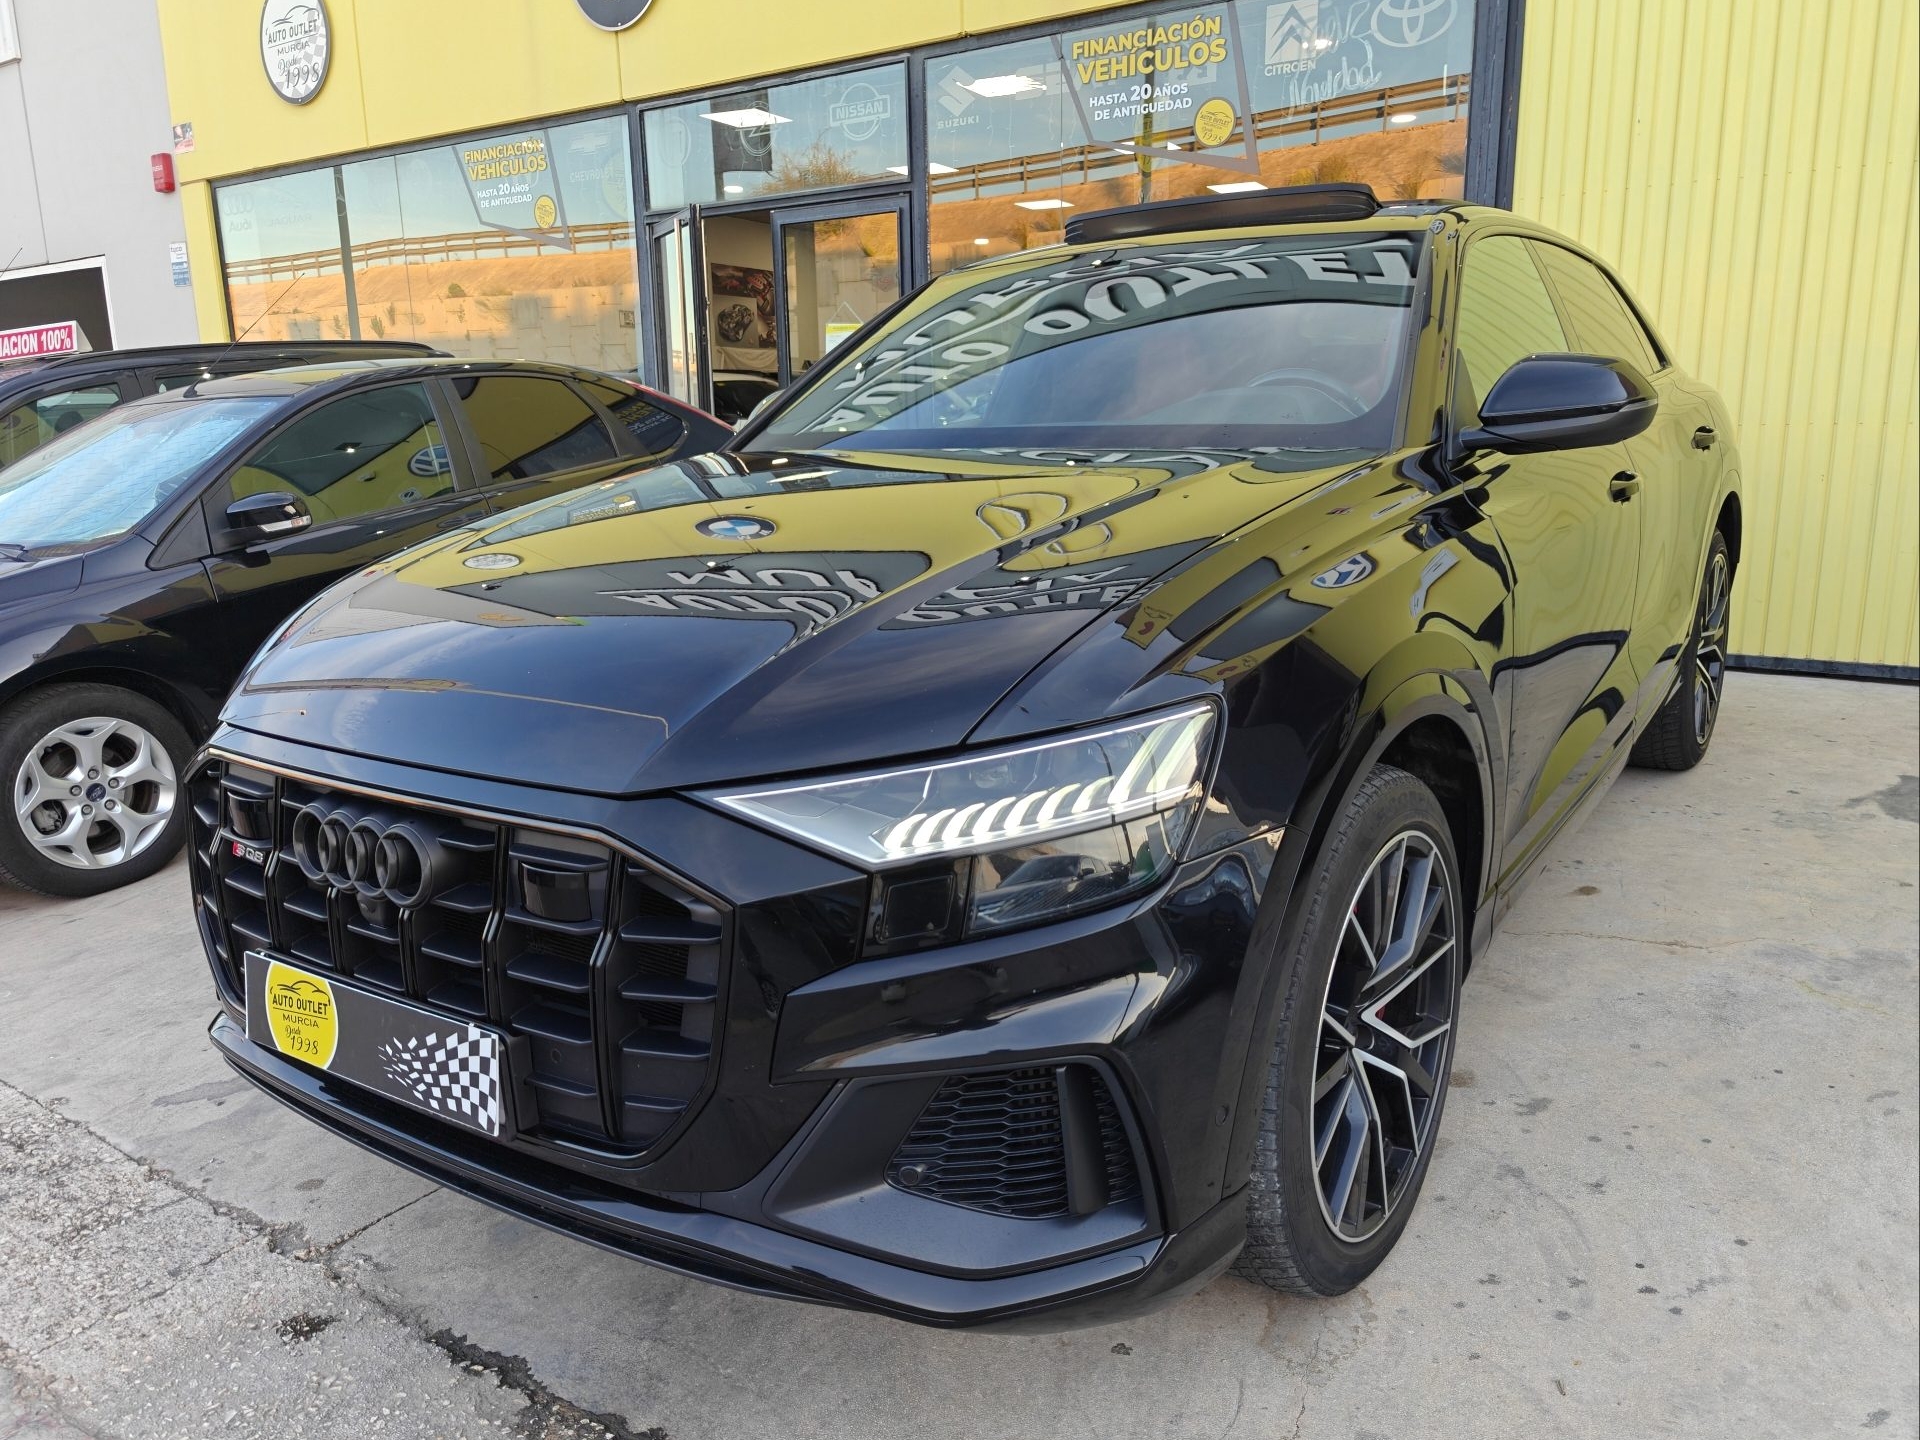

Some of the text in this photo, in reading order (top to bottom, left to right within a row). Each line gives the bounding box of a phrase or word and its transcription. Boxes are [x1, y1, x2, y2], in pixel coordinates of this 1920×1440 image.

[268, 19, 317, 45] AUTO OUTLET
[1072, 14, 1221, 60] FINANCIACIÓN
[277, 40, 310, 56] MURCIA
[1076, 39, 1227, 84] VEHÍCULOS
[285, 62, 320, 89] 1998
[1089, 83, 1189, 108] HASTA 20 AÑOS
[836, 100, 883, 120] NISSAN
[1094, 110, 1111, 121] DE
[937, 115, 979, 130] SUZUKI
[464, 136, 545, 164] FINANCIACIÓN
[468, 154, 547, 182] VEHÍCULOS
[477, 183, 529, 199] HASTA 20 AÑOS
[480, 200, 490, 208] DE
[41, 328, 71, 352] 100%
[234, 841, 264, 863] SQ8
[272, 993, 328, 1016] AUTO OUTLET
[282, 1013, 320, 1029] MURCIA
[290, 1035, 319, 1055] 1998
